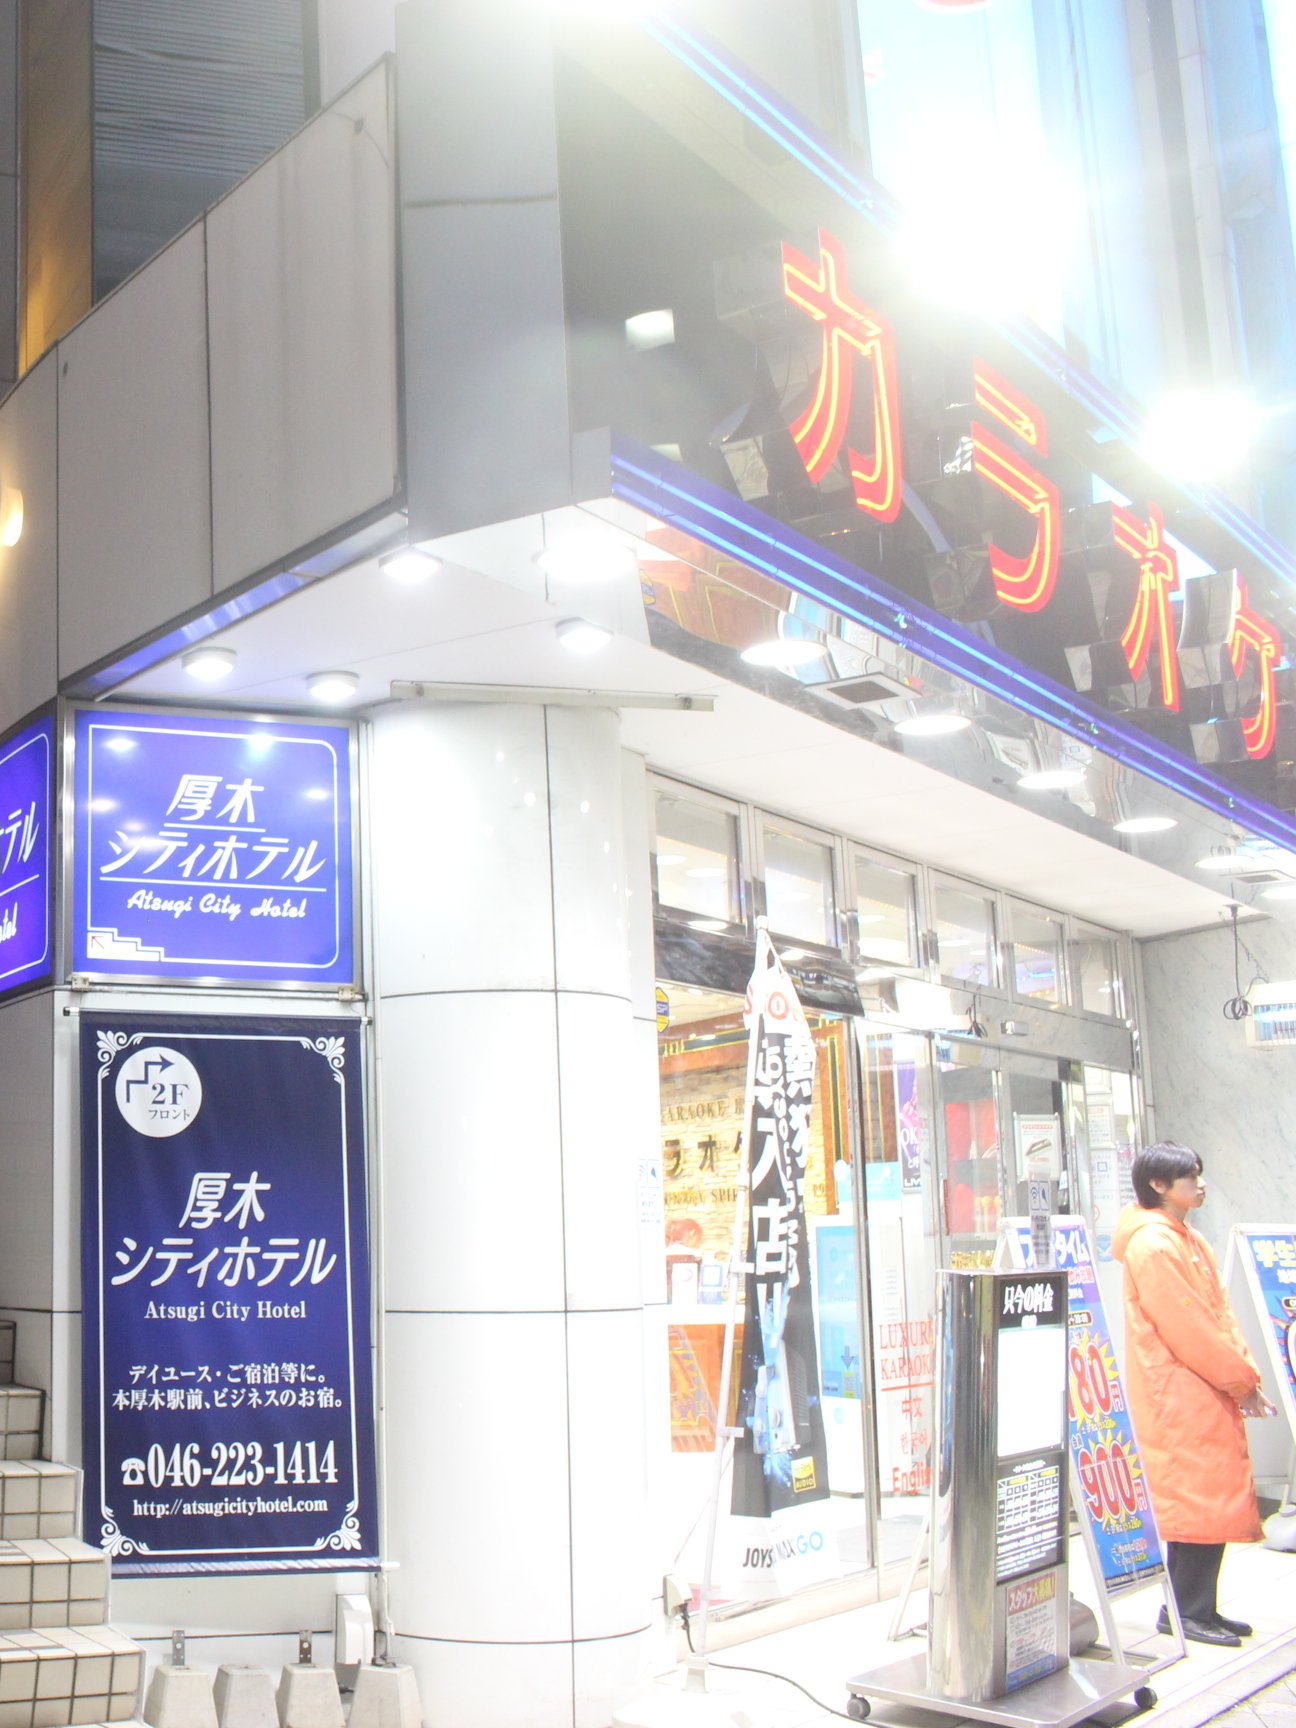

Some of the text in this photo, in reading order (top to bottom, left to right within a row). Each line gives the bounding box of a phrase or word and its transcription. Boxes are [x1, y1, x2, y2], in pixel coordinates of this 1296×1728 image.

[166, 774, 265, 824] 厚木
[100, 830, 327, 883] シティホテル
[127, 889, 306, 921] Atsugi City Hotel
[151, 1082, 190, 1106] 2F
[148, 1108, 190, 1122] フロント
[662, 1100, 726, 1123] ARAOKE
[179, 1171, 271, 1230] 厚木
[111, 1236, 337, 1288] シティホテル
[1252, 1239, 1296, 1268] 学生
[144, 1300, 306, 1322] Atsugi City Hotel
[1003, 1282, 1054, 1314] 只今の料金
[128, 1363, 328, 1385] デイユース・ご宿泊等に。
[111, 1388, 343, 1410] 本厚木駅前、ビジネスのお宿。
[901, 1397, 923, 1420] 中文
[147, 1440, 339, 1488] 046-223-1414
[1078, 1440, 1148, 1523] 900円
[132, 1496, 329, 1518] http://atsugicityhotel.com
[797, 1530, 824, 1555] GO
